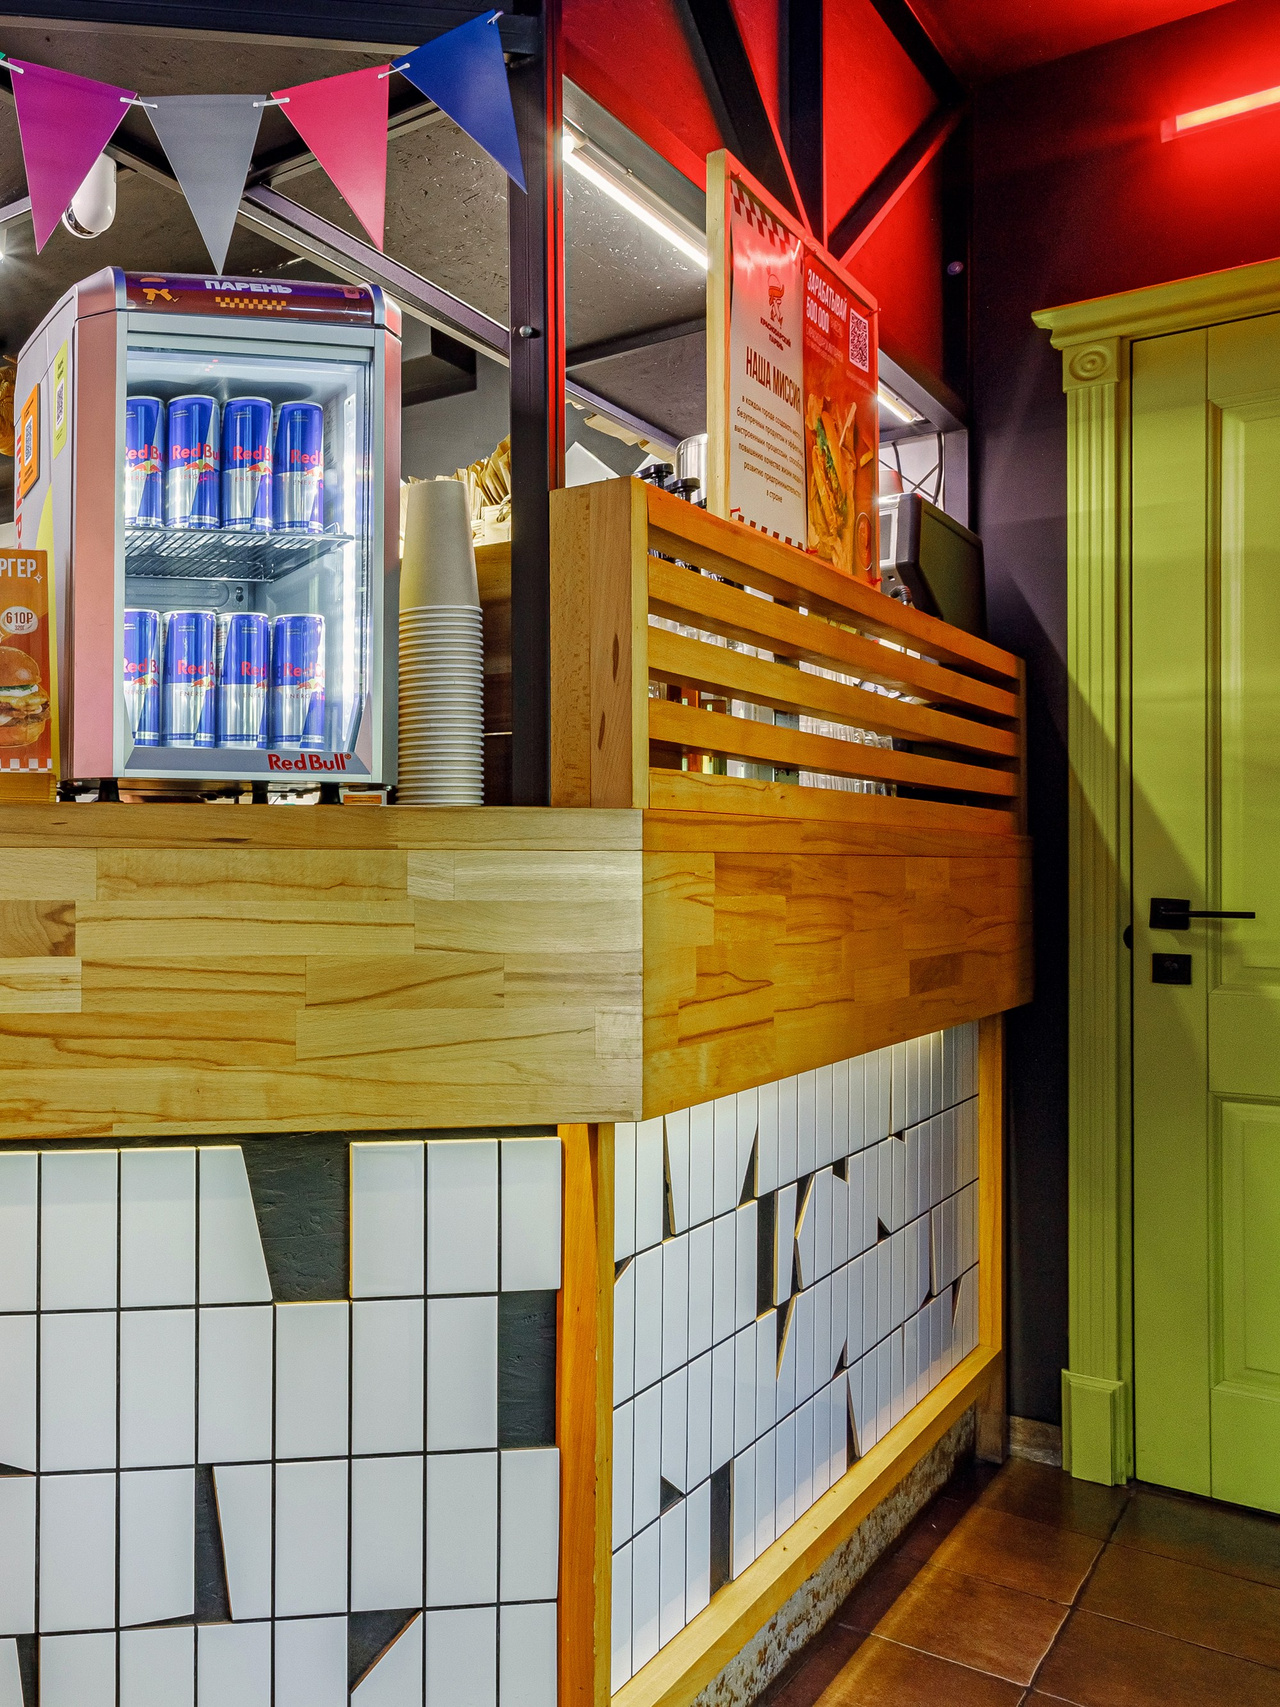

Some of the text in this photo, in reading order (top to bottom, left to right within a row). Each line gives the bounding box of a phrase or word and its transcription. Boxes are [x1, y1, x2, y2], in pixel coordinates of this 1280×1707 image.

[205, 280, 292, 294] ПАРЕНЬ
[807, 268, 847, 322] ЗАРАБАТЫВАЙ
[806, 296, 818, 324] 500
[818, 306, 829, 334] 000
[746, 346, 771, 391] НАША
[773, 366, 800, 414] МИССИЯ
[173, 443, 201, 460] Red
[233, 445, 262, 461] Red
[291, 449, 318, 465] Red
[178, 659, 207, 675] Red
[284, 661, 312, 677] Red
[267, 753, 307, 770] Red
